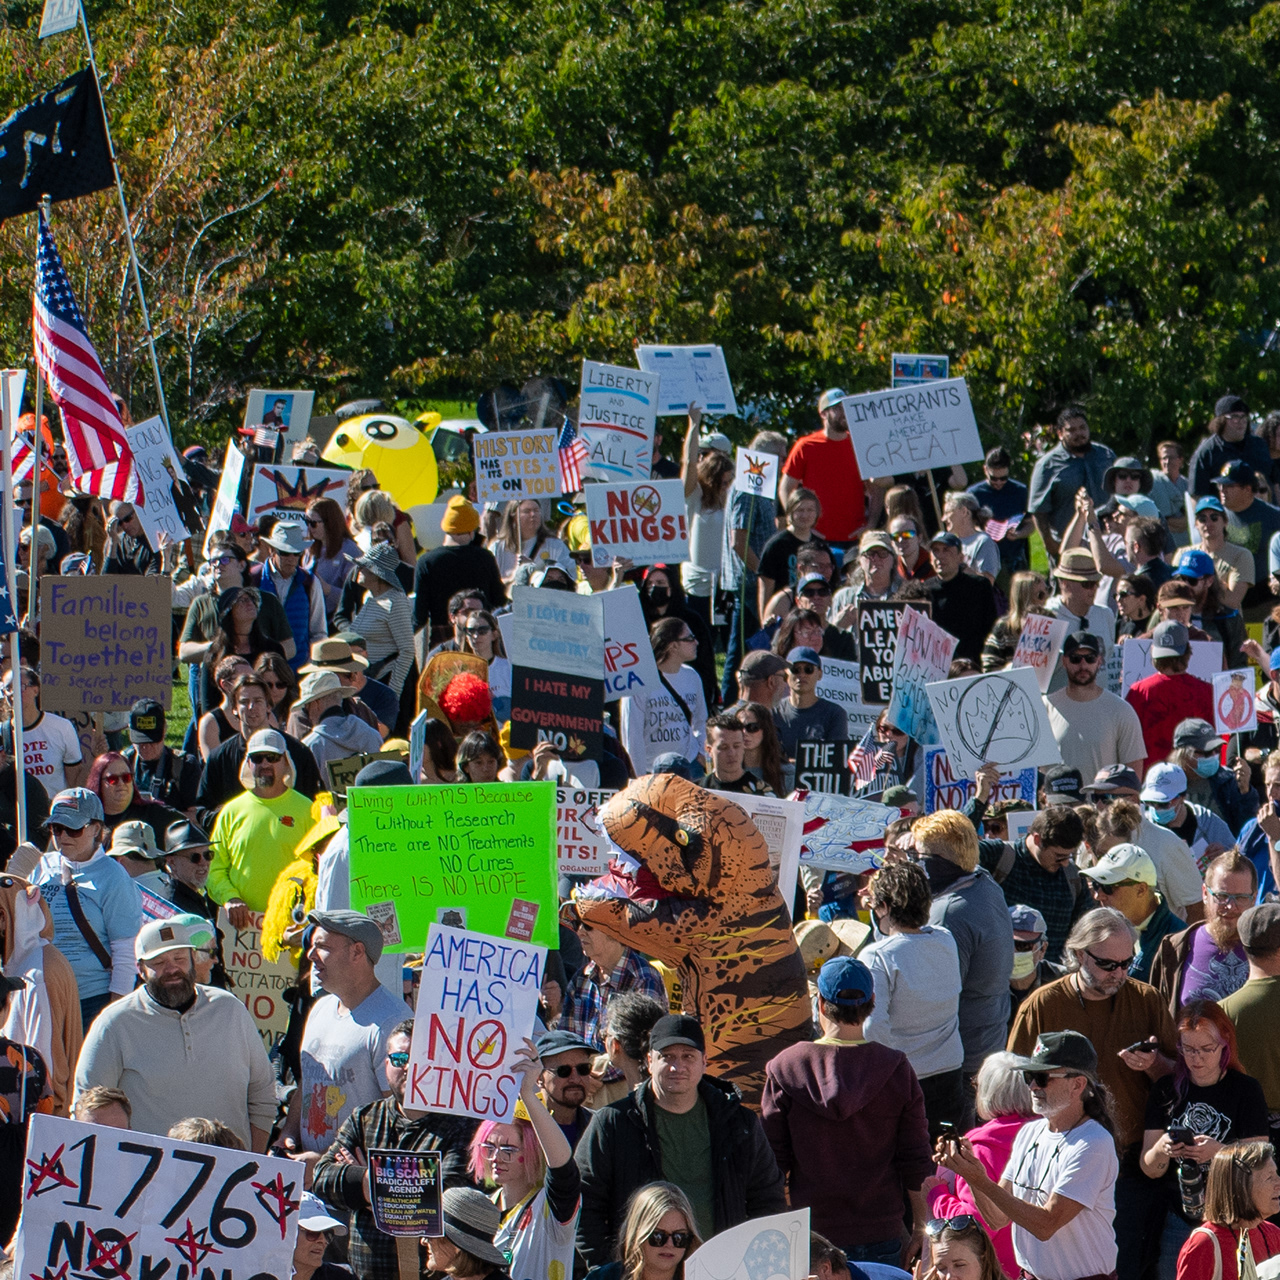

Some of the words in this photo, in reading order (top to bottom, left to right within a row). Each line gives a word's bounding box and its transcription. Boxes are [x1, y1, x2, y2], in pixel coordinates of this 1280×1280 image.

[589, 369, 652, 393] LIBERTY
[585, 404, 644, 429] JUSTICE
[850, 387, 961, 423] IMMIGRANTS
[475, 436, 555, 458] HISTORY
[866, 428, 961, 468] GREAT
[480, 459, 500, 469] HAS
[504, 459, 540, 476] EYES
[502, 479, 522, 490] ON
[525, 477, 555, 495] YOU
[591, 516, 688, 544] KINGS!
[50, 584, 149, 618] Families
[84, 619, 158, 647] belong
[46, 640, 165, 671] Together!
[40, 673, 56, 685] no
[69, 675, 116, 689] secret
[123, 668, 170, 688] police
[512, 707, 601, 733] GOVERNMENT
[445, 810, 515, 828] Research
[355, 832, 398, 853] There
[407, 838, 430, 851] are
[438, 834, 460, 851] NO
[461, 830, 535, 851] Treatments
[440, 855, 462, 874] NO
[469, 853, 514, 872] Cures
[351, 876, 401, 899] There
[413, 875, 434, 897] IS
[443, 874, 467, 895] NO
[475, 872, 527, 895] HOPE
[425, 932, 539, 989] AMERICA
[440, 977, 504, 1014] HAS
[427, 1013, 507, 1070] NO
[411, 1063, 515, 1115] KINGS
[375, 1167, 395, 1177] BIG
[397, 1168, 435, 1178] SCARY
[376, 1178, 413, 1186] RADICAL
[415, 1178, 435, 1186] LEFT
[64, 1134, 259, 1249] 1776
[389, 1185, 424, 1194] AGENDA
